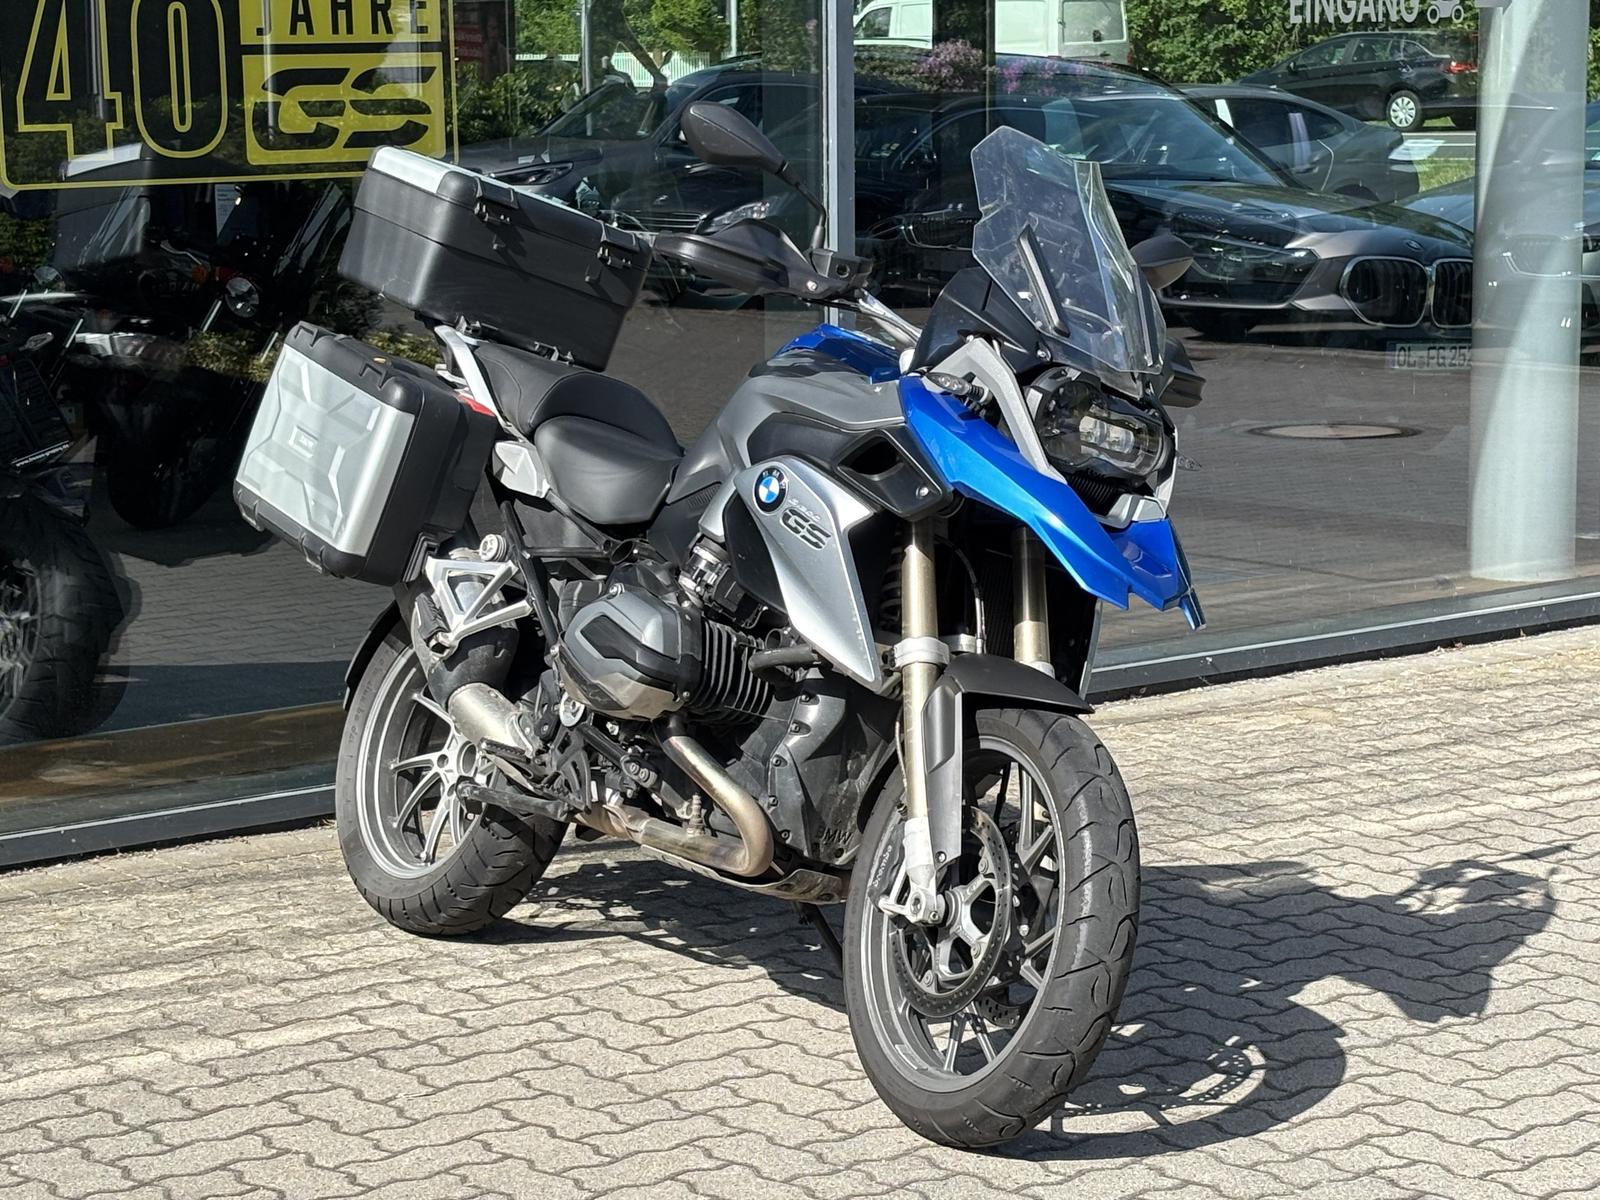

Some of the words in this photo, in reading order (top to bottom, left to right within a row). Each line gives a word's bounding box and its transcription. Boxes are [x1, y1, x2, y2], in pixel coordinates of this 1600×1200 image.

[256, 0, 429, 36] JAHRE
[17, 0, 229, 161] 40
[250, 66, 437, 150] GS
[781, 508, 832, 550] GS
